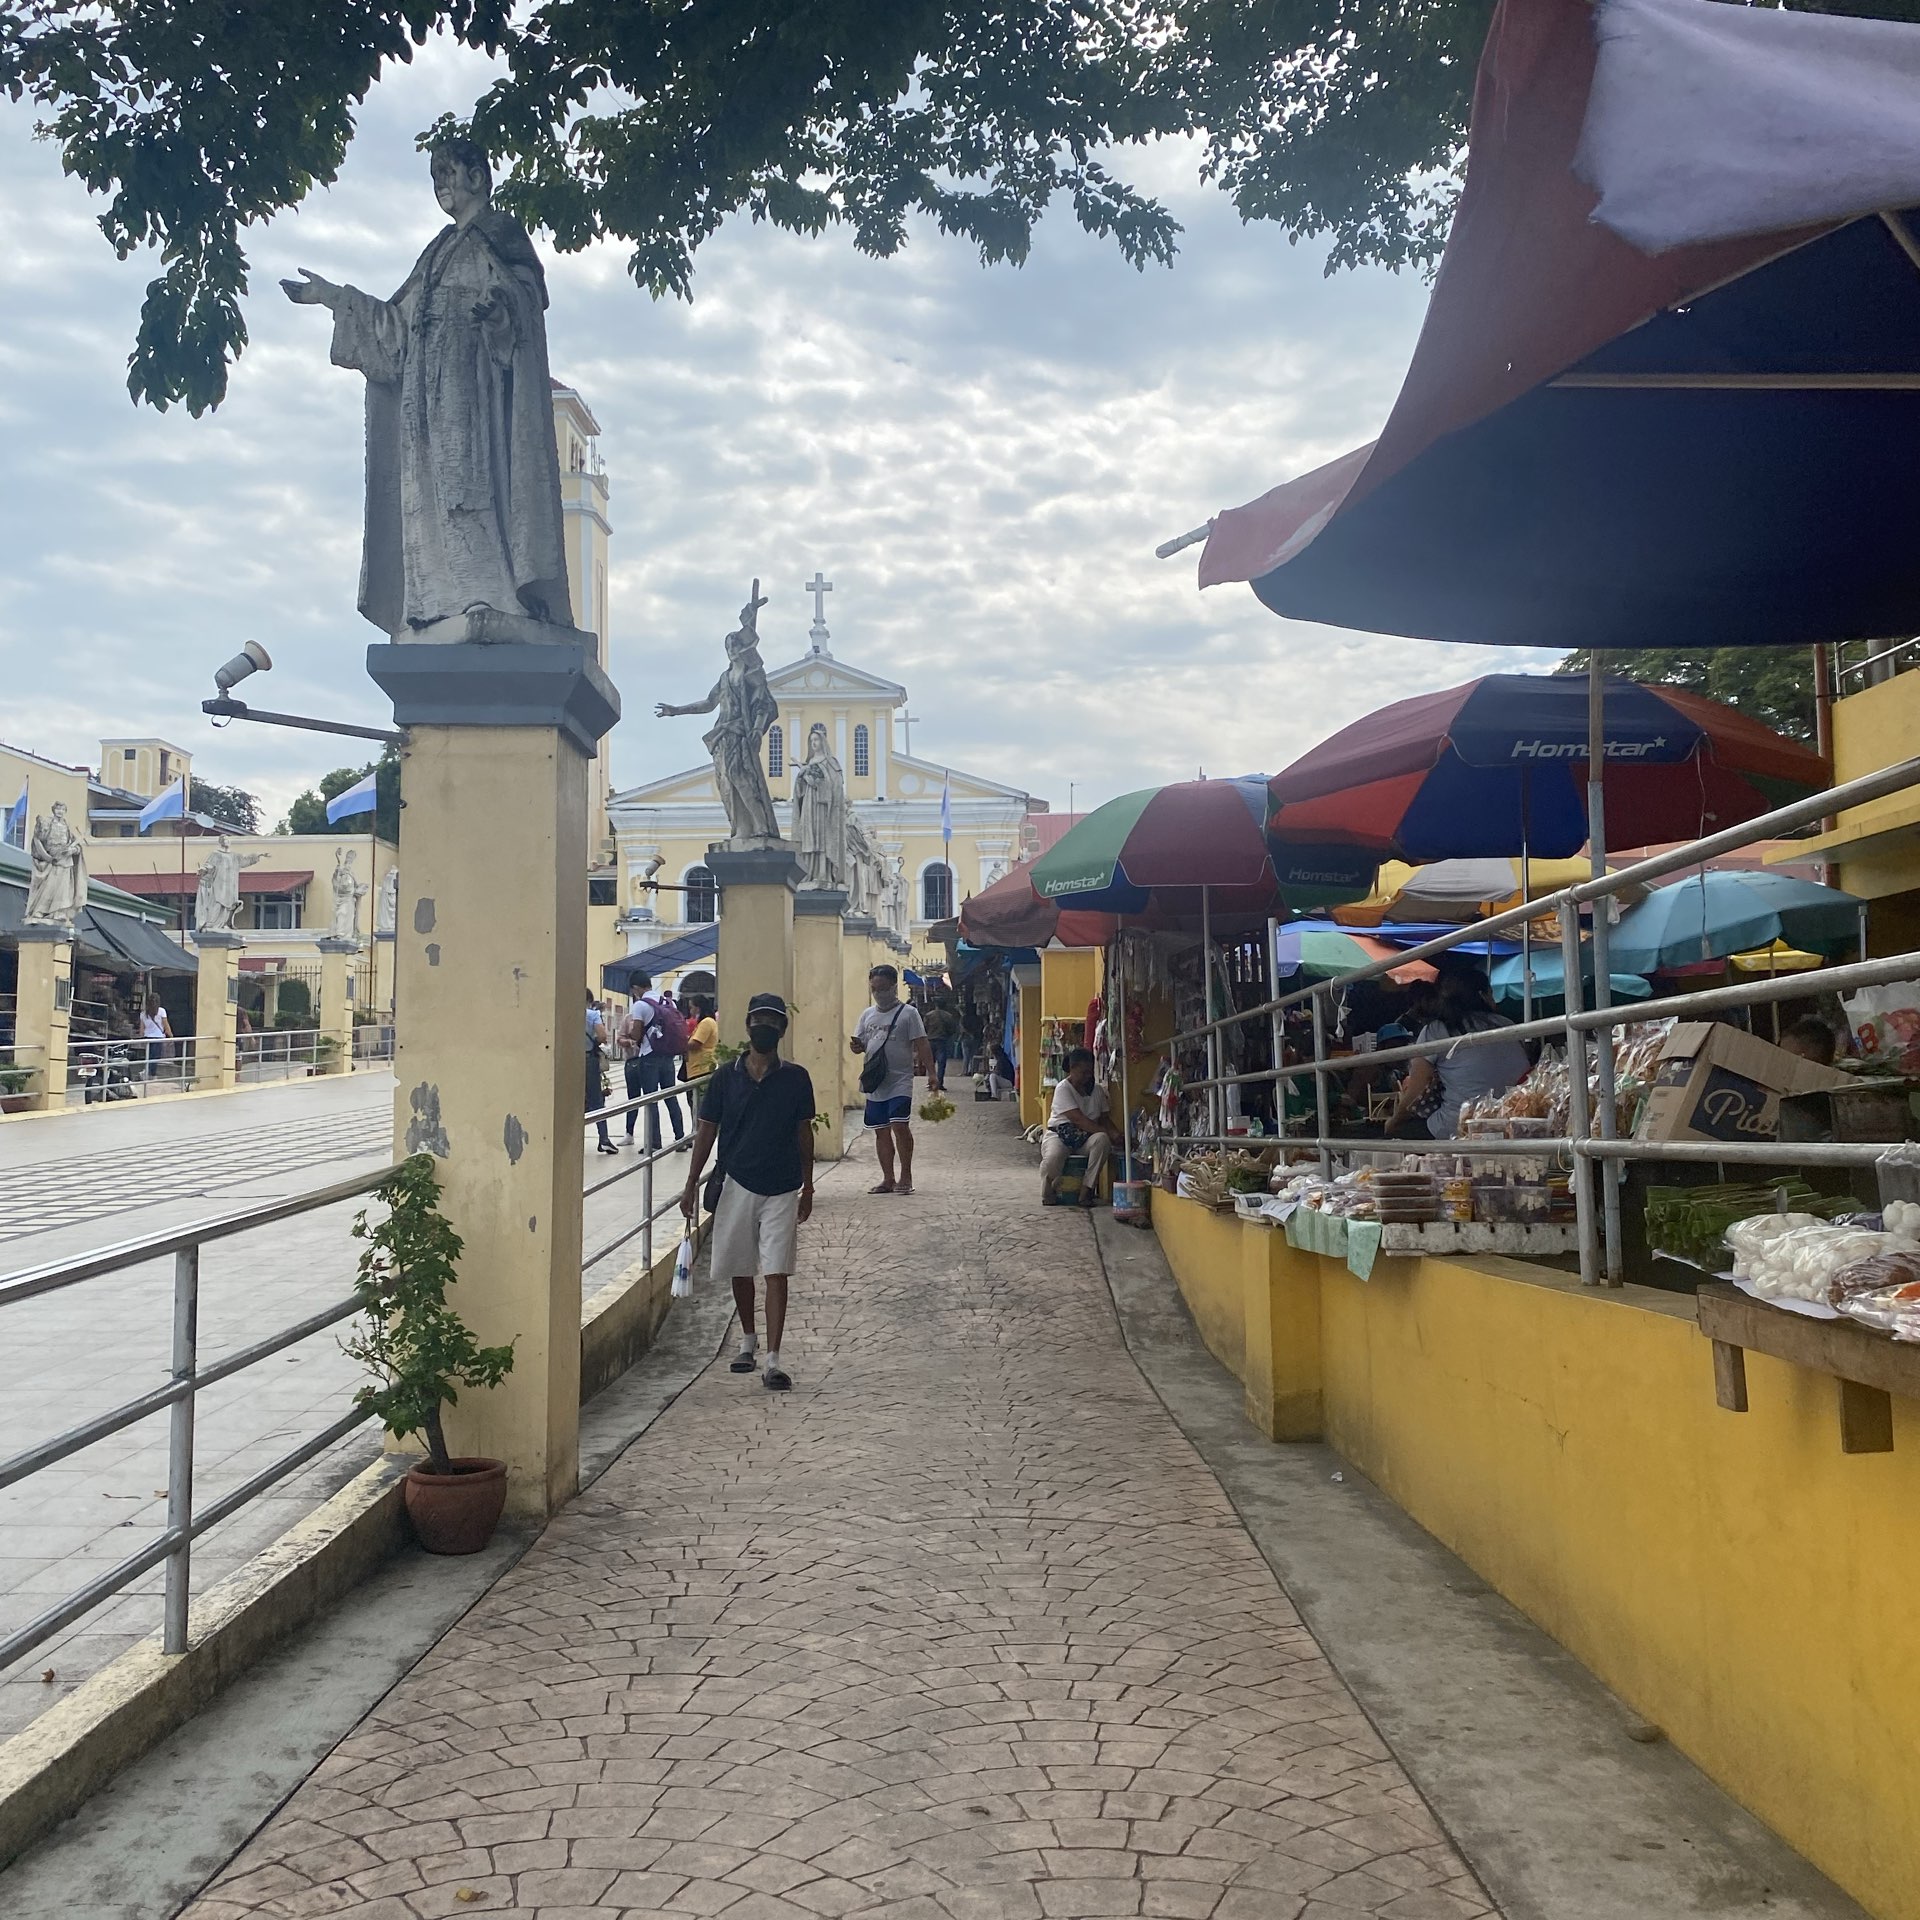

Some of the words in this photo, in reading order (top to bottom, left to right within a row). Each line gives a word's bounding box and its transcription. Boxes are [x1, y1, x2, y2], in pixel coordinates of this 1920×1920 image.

[1511, 740, 1656, 758] Homtar
[1288, 866, 1354, 882] Homstar
[1044, 876, 1101, 893] Homstar
